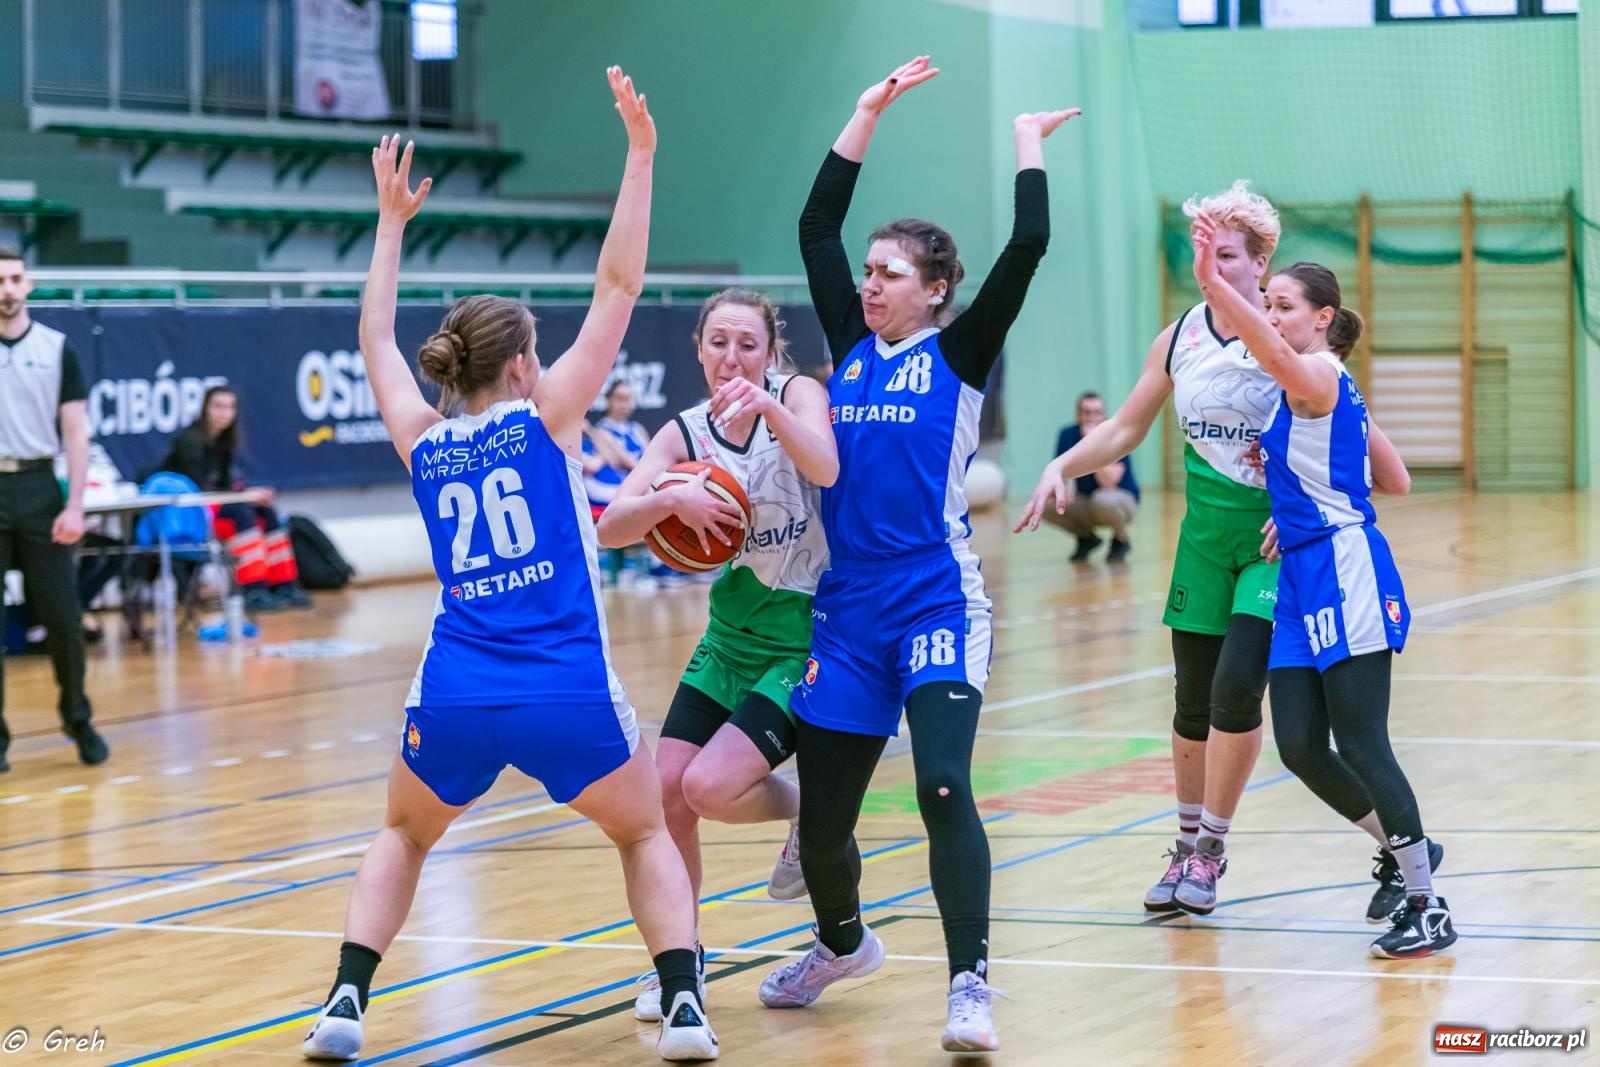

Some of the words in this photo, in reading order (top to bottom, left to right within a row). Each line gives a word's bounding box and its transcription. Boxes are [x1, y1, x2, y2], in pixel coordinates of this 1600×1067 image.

[421, 447, 470, 467] MKS
[474, 424, 525, 455] MOS
[1188, 421, 1261, 442] Clavis
[437, 467, 536, 574] 26
[461, 560, 555, 601] BETARD
[909, 628, 956, 674] 88
